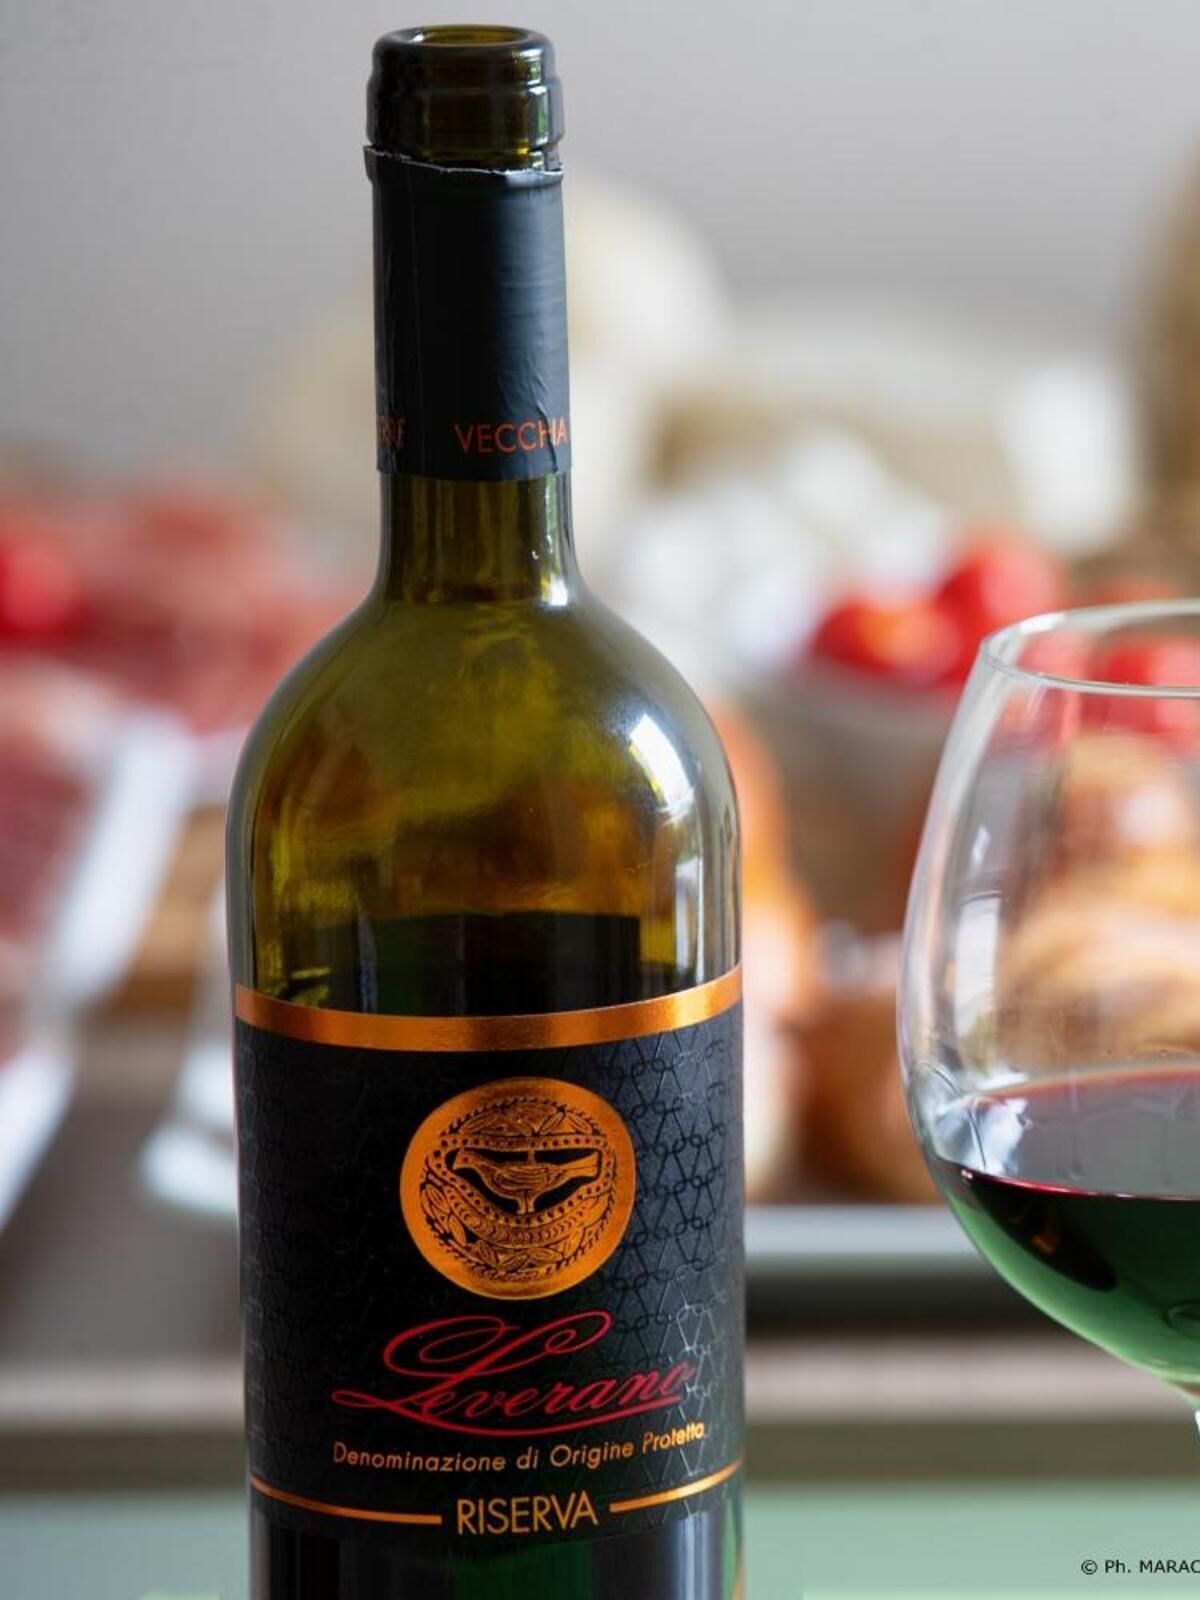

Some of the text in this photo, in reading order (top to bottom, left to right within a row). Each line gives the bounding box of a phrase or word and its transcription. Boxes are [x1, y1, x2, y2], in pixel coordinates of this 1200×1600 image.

[332, 1311, 696, 1436] Leverano
[333, 1441, 506, 1472] Denominazione
[517, 1442, 540, 1469] di
[550, 1437, 635, 1469] Origine
[457, 1491, 599, 1535] RISERVA
